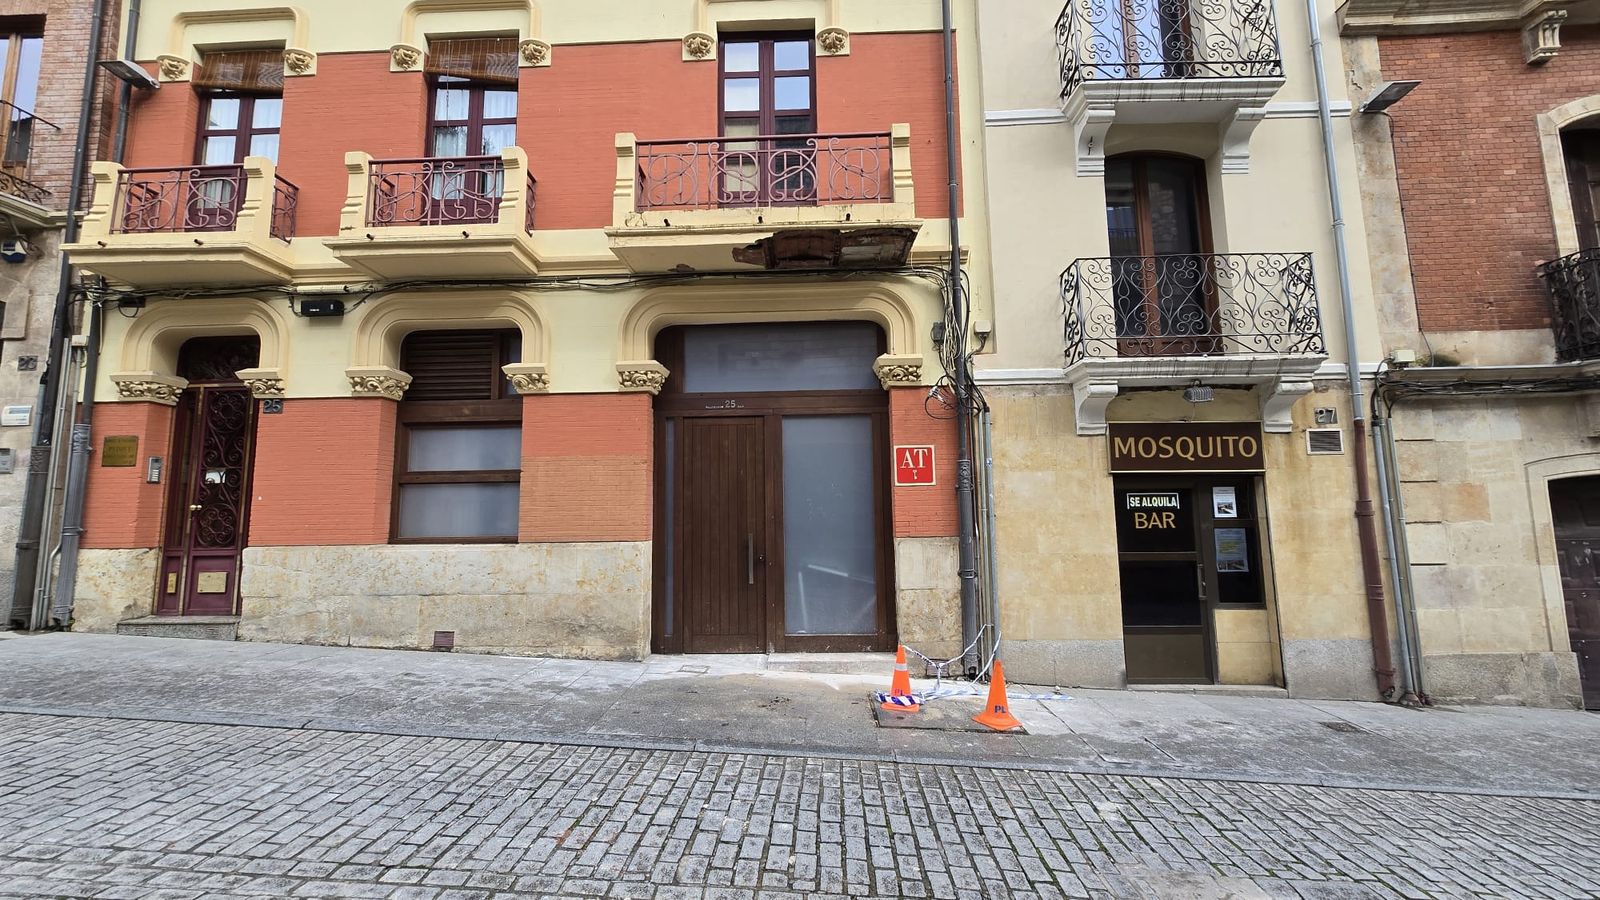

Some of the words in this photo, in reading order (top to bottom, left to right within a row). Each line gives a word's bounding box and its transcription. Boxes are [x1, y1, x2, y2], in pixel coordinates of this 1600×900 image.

[264, 399, 282, 413] 25
[725, 399, 736, 408] 25
[1316, 408, 1336, 423] 27
[1113, 435, 1258, 461] MOSQUITO
[900, 448, 928, 469] AT
[1129, 496, 1141, 507] SE
[1142, 496, 1177, 508] ALQUILA
[1134, 512, 1176, 529] BAR
[994, 705, 1007, 713] PL
